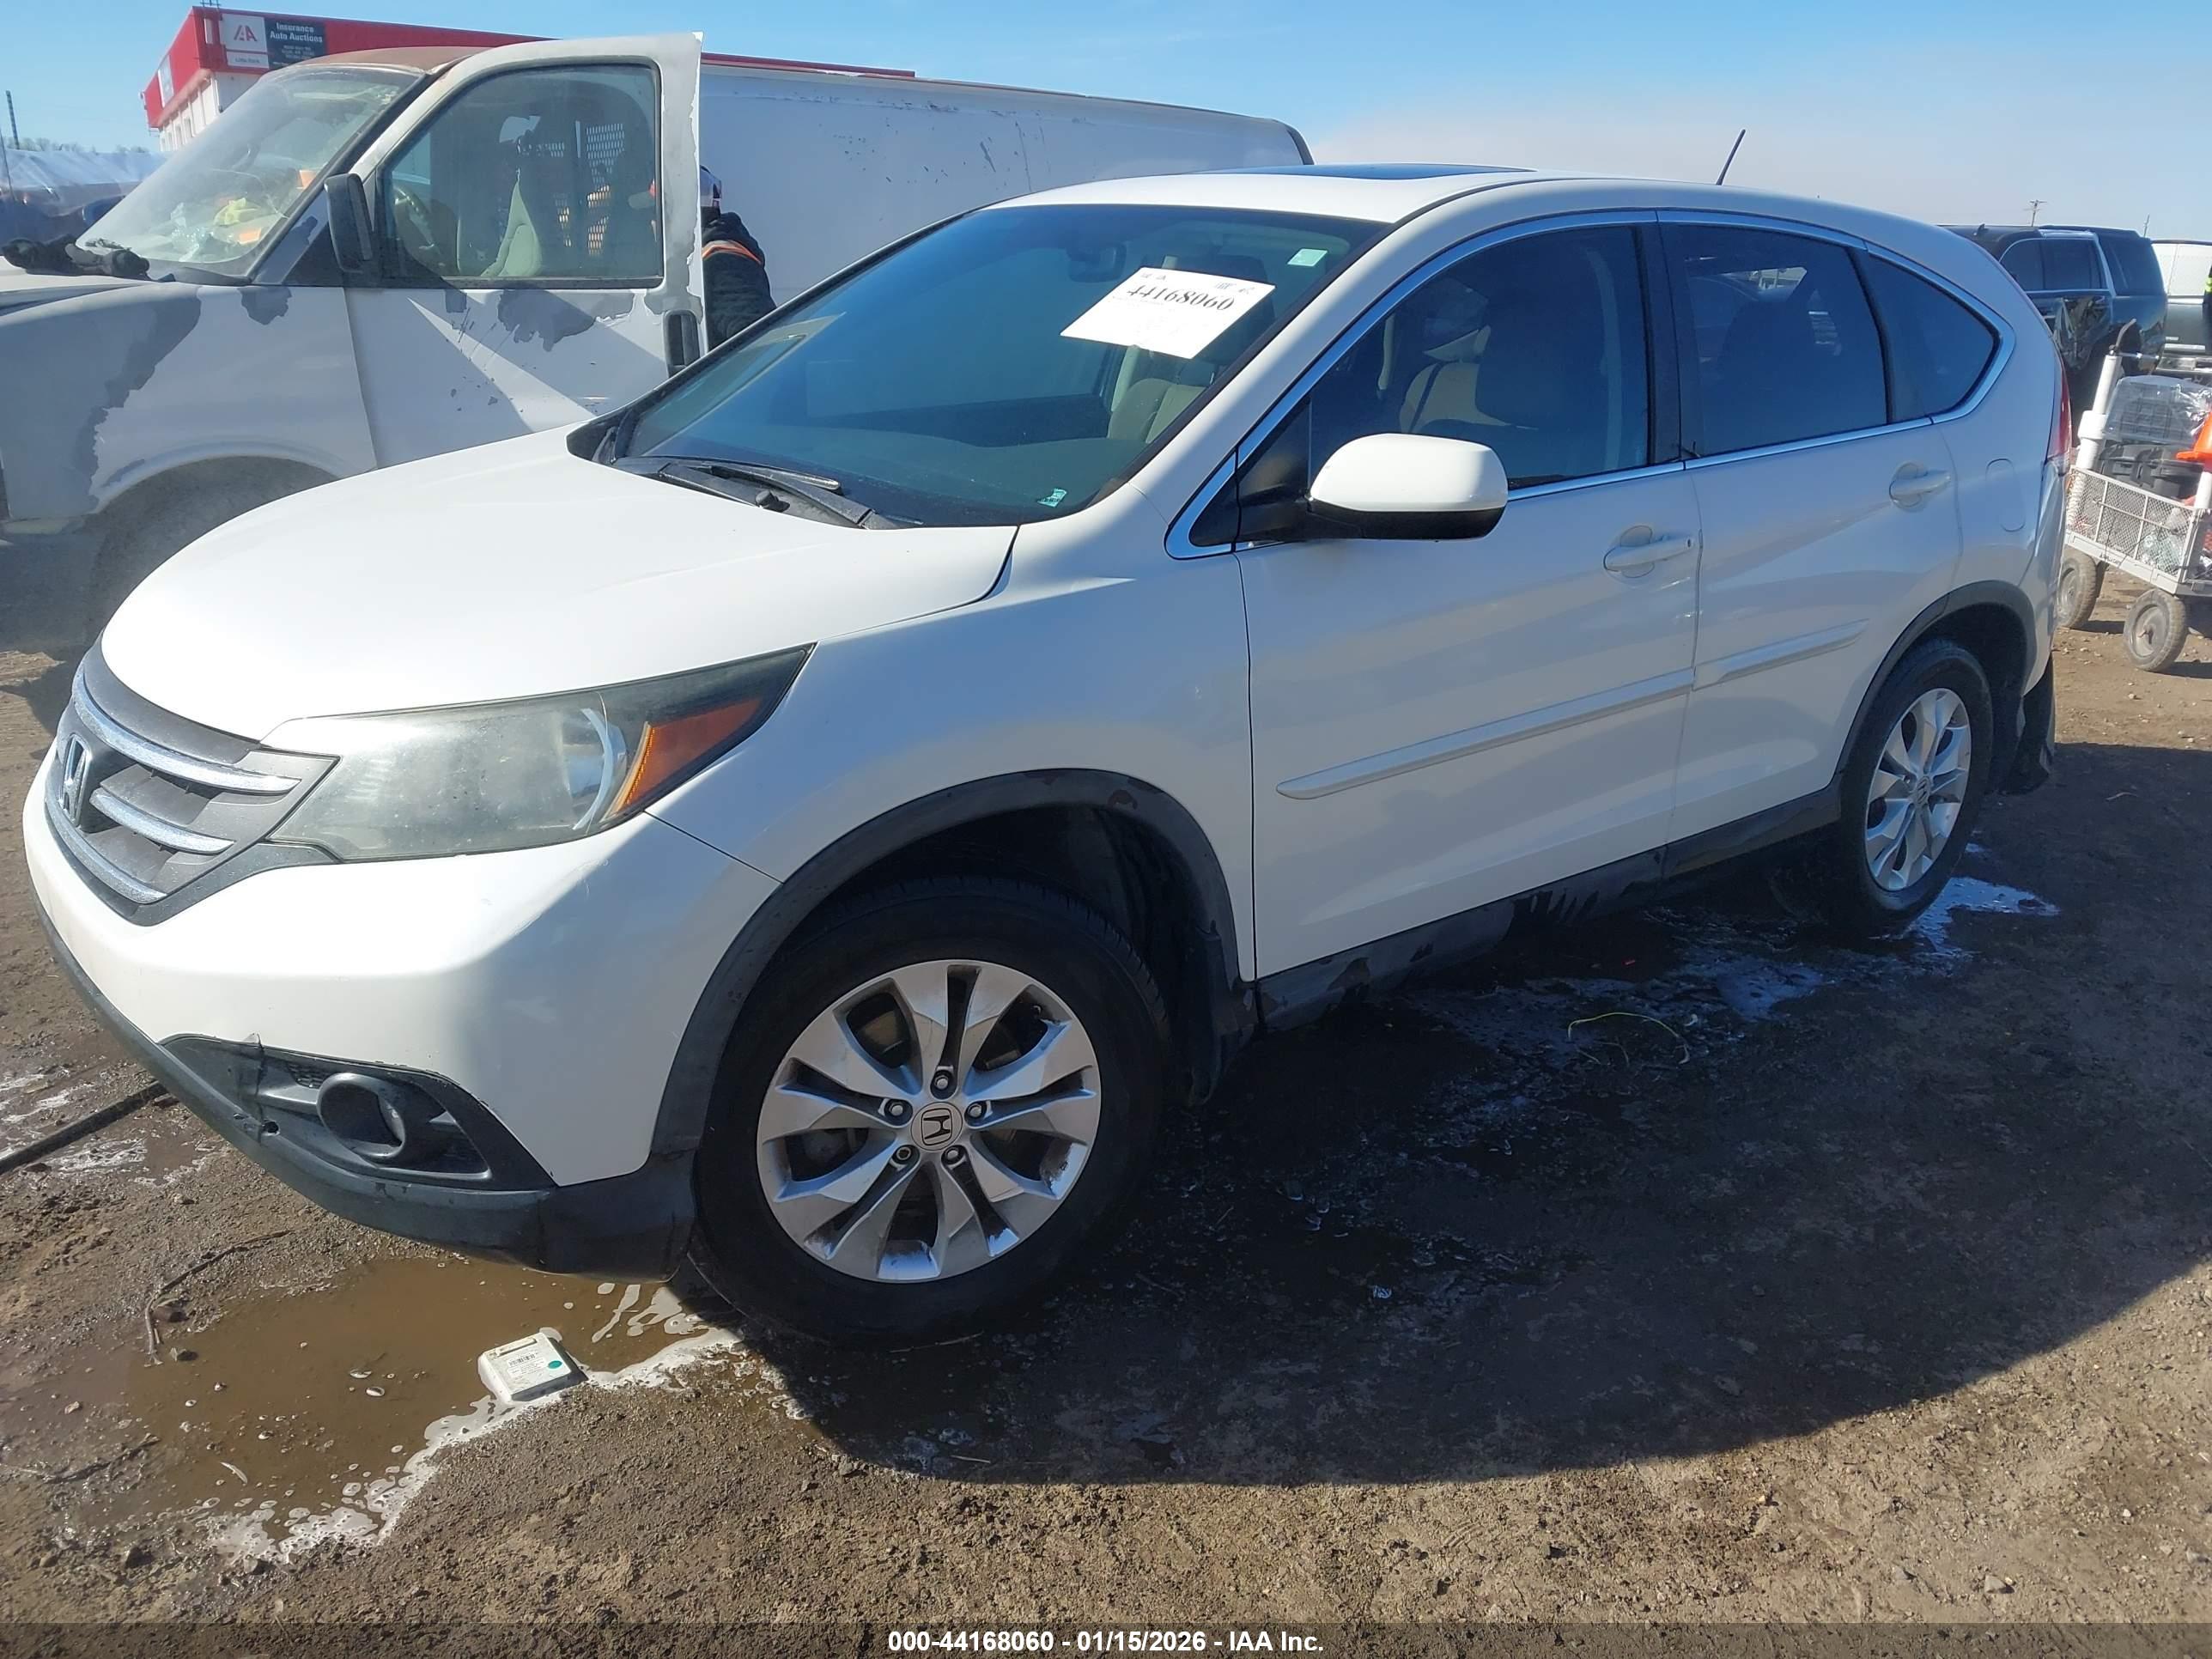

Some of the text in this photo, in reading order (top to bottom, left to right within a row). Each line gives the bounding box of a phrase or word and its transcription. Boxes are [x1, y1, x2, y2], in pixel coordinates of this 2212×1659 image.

[276, 21, 314, 33] Insurance
[270, 31, 323, 43] Auto Auctions
[1127, 284, 1235, 311] 44168060
